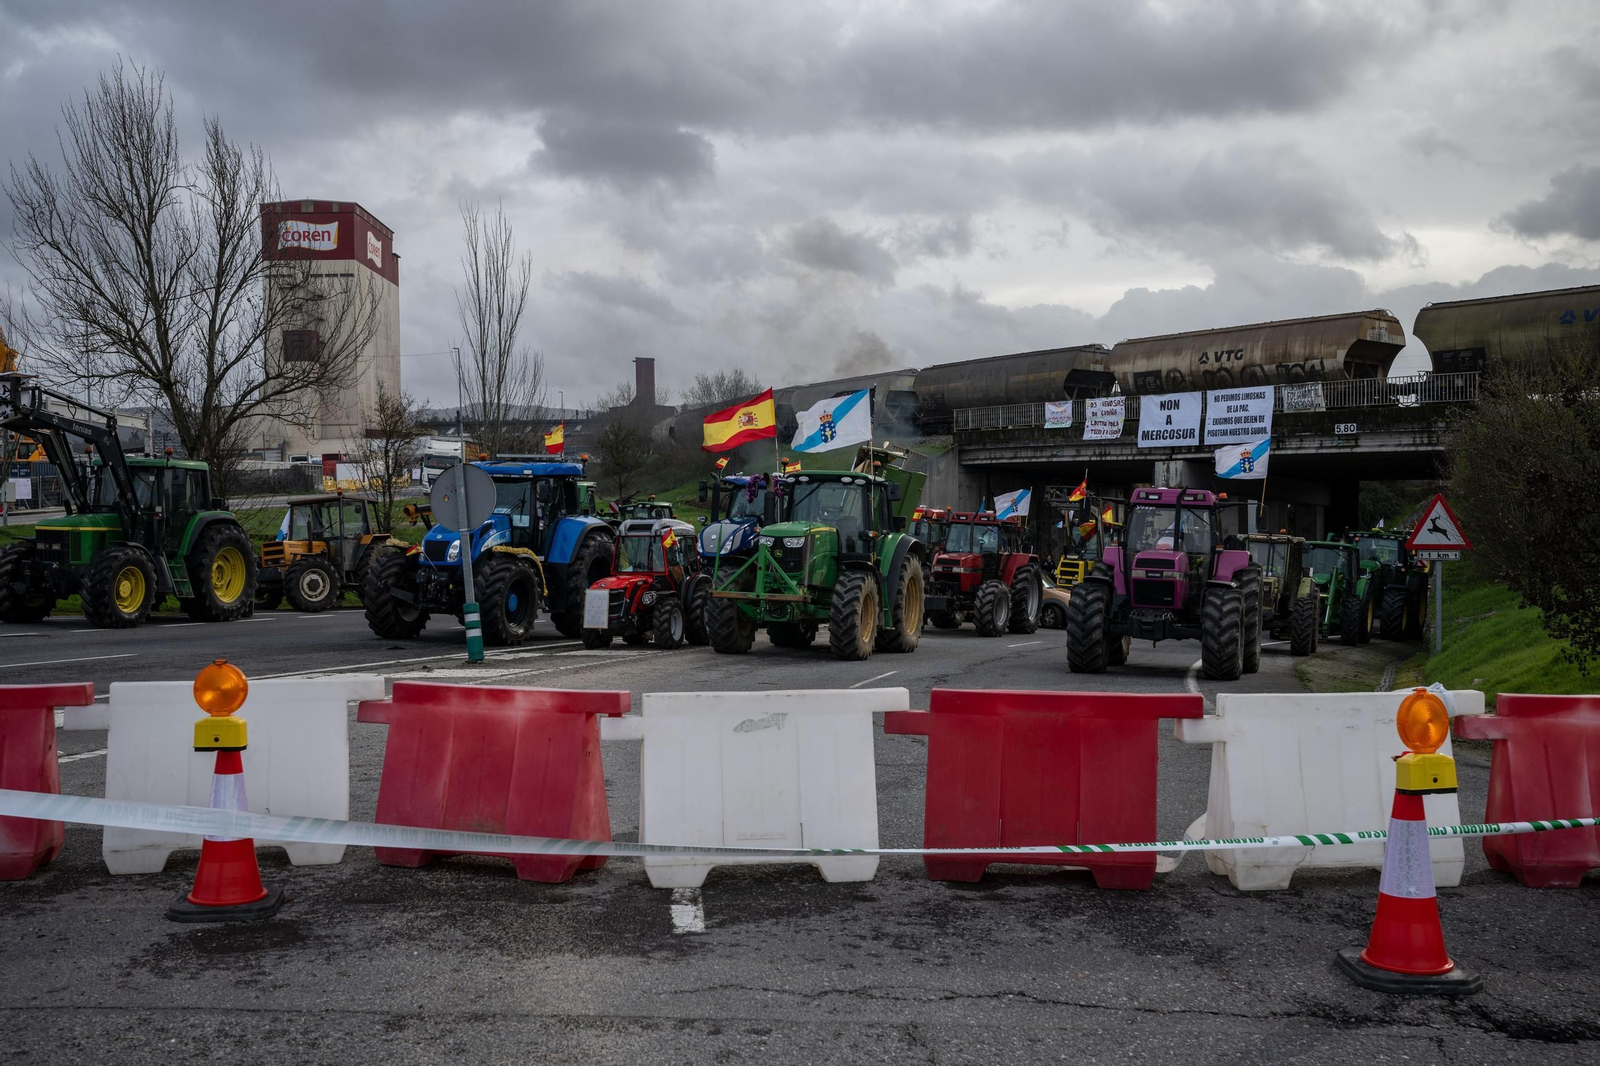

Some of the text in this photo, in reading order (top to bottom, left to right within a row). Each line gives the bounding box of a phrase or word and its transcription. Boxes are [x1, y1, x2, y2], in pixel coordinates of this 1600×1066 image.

[1214, 348, 1244, 363] VTG
[1221, 392, 1241, 402] PEDIMOS
[1241, 391, 1266, 401] LIMOSNAS
[1160, 399, 1180, 411] NON
[1226, 405, 1232, 413] DE
[1233, 404, 1239, 412] LA
[1165, 414, 1172, 426] A
[1212, 415, 1265, 425] EXIGIMOS QUE DEJEN DE
[1141, 428, 1196, 441] MERCOSUR
[1207, 429, 1228, 437] PISOTEAR
[1229, 427, 1250, 436] NUESTRO
